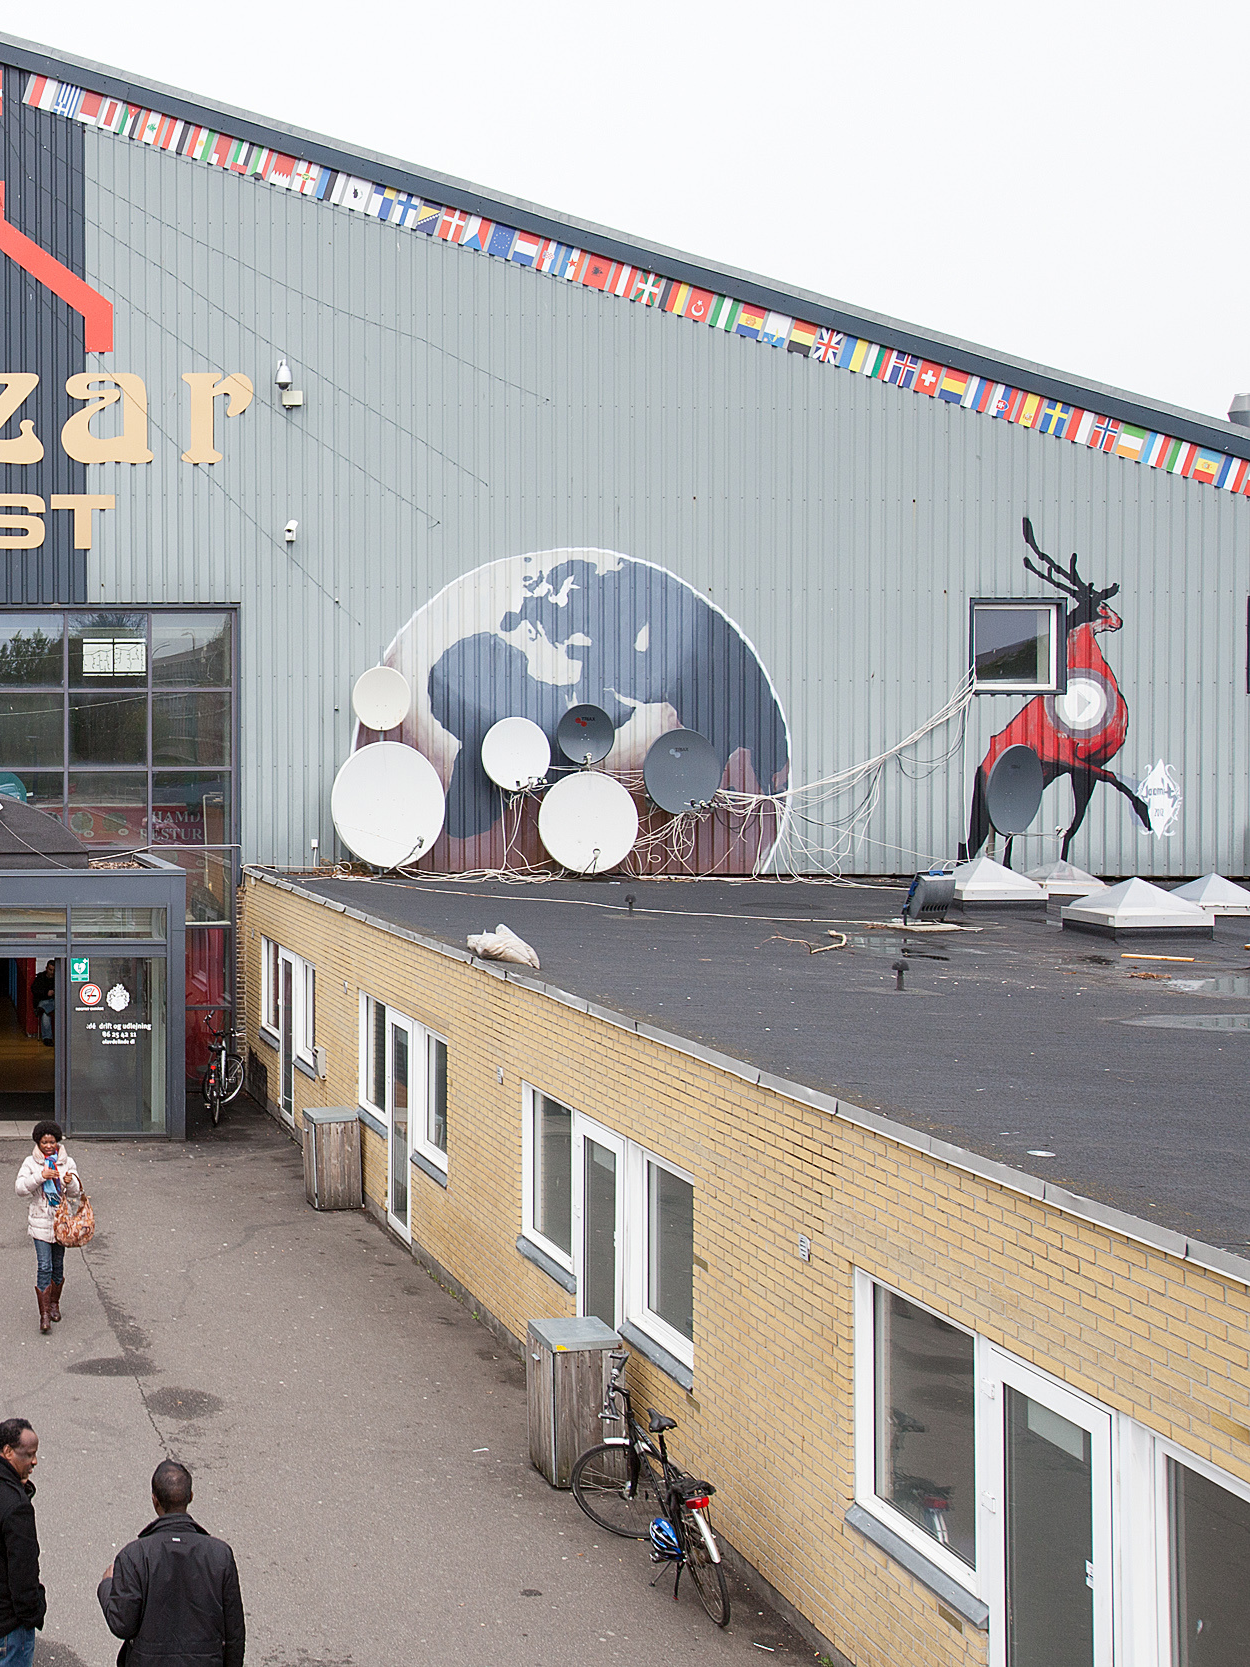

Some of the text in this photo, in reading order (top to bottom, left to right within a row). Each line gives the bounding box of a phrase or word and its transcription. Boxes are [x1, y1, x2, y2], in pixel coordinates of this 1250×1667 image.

[151, 811, 205, 823] HAMD
[140, 828, 205, 841] RESTUR
[98, 1022, 112, 1030] drift
[113, 1023, 121, 1031] og
[122, 1022, 152, 1031] udlejning
[101, 1030, 111, 1038] 86
[111, 1031, 120, 1039] 25
[120, 1031, 129, 1039] 42
